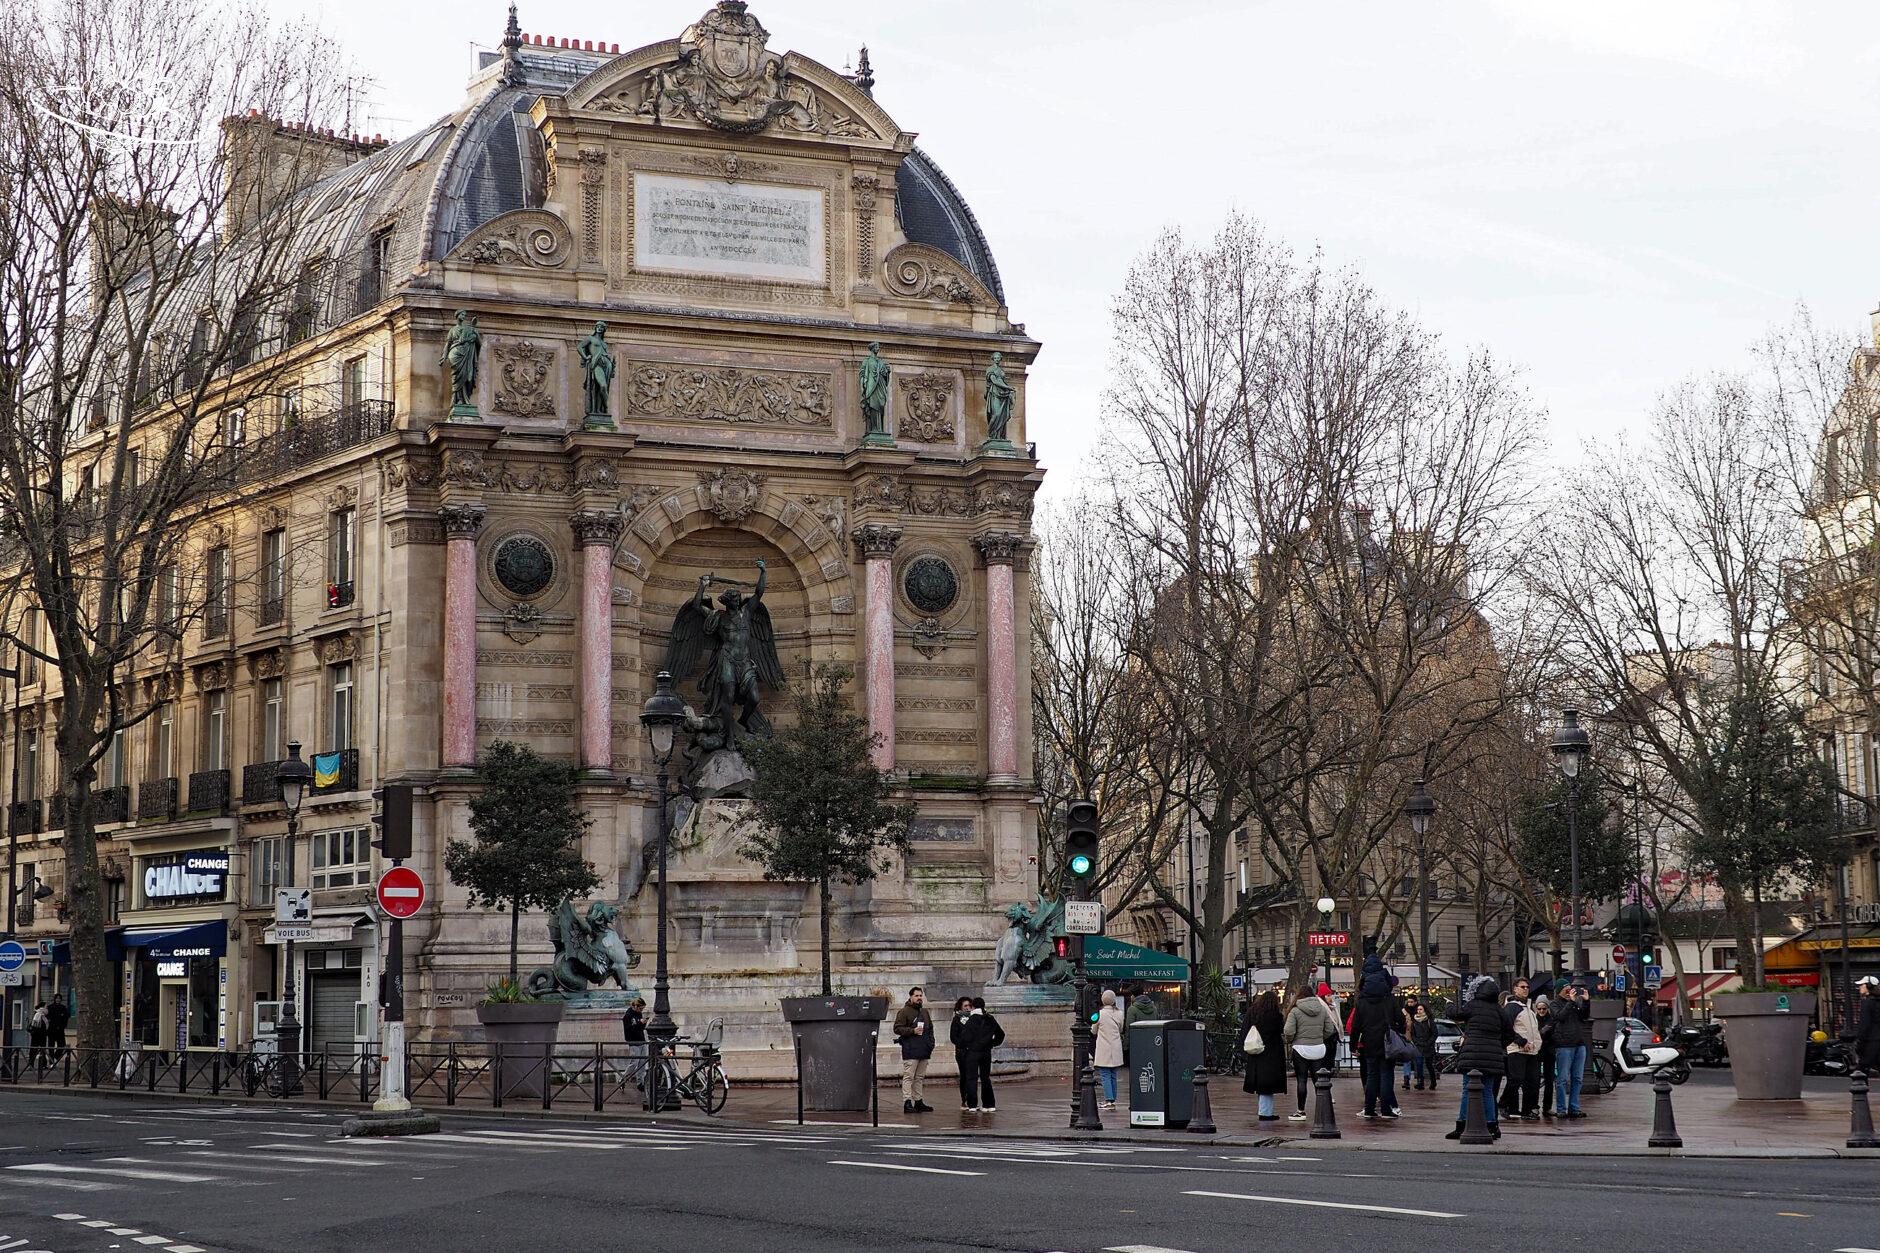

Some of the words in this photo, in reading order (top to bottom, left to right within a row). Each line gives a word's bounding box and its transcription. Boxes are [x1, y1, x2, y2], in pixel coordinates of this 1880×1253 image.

[721, 203, 745, 212] SAINT
[187, 858, 229, 870] CHANGE
[144, 864, 221, 898] CHANGE
[277, 929, 294, 937] VOIE
[296, 929, 311, 937] BUS
[1309, 934, 1346, 945] METRO
[172, 947, 211, 957] CHANGE
[1096, 948, 1116, 960] Saint
[1116, 948, 1141, 960] Michel
[156, 962, 185, 977] CHANGE
[1134, 969, 1176, 977] BREAKFAST
